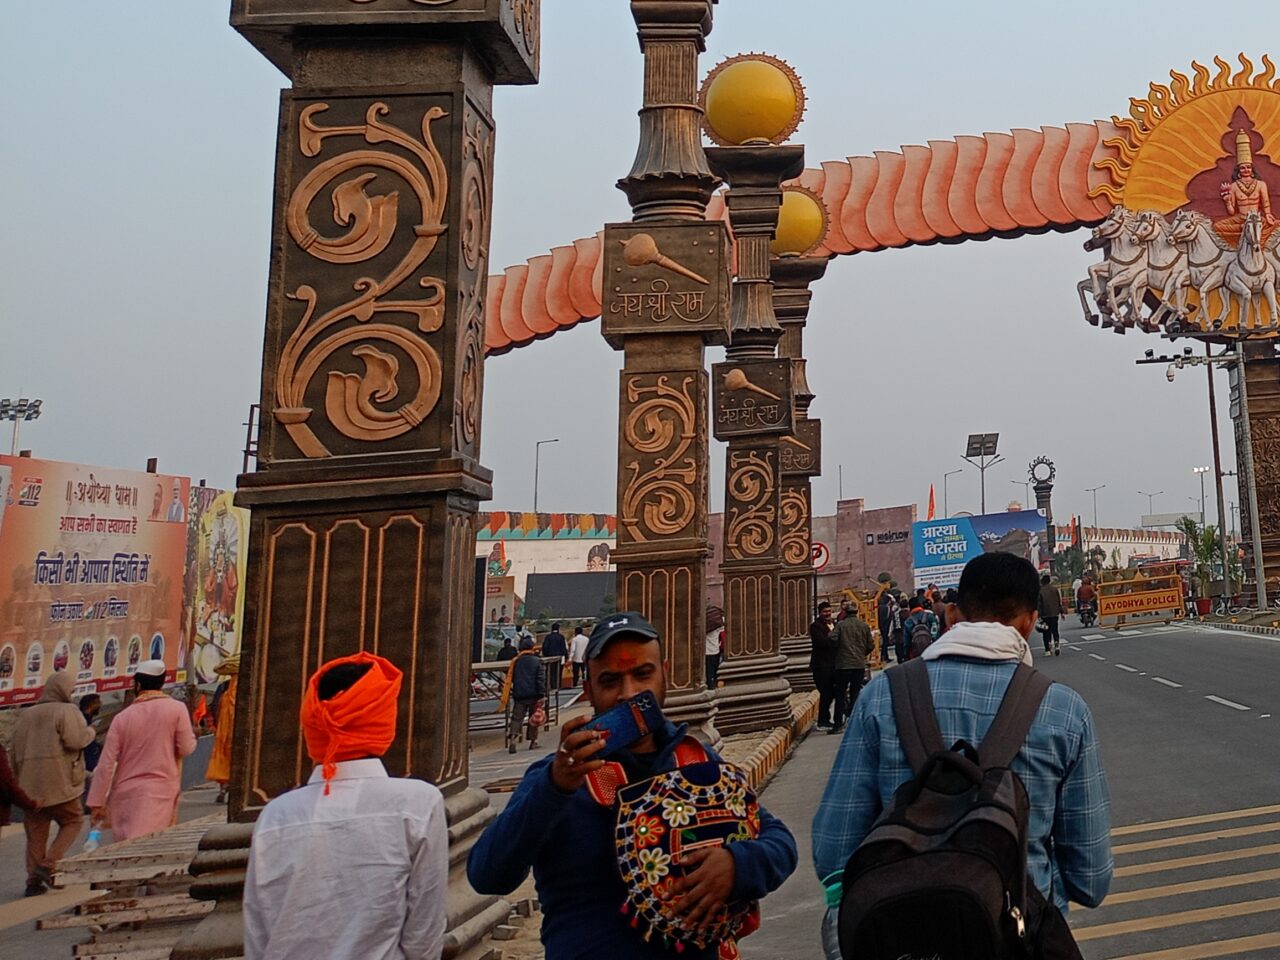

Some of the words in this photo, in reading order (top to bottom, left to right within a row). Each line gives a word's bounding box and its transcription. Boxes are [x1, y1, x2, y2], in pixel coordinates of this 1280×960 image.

[610, 292, 647, 317] जय
[645, 278, 672, 322] श्री
[671, 290, 717, 322] राम
[718, 408, 740, 424] जय
[59, 516, 75, 531] आप
[77, 513, 95, 532] सभी
[97, 518, 107, 532] का
[921, 524, 957, 538] आस्था
[924, 540, 967, 555] विरासत
[34, 551, 64, 584] किसी
[64, 552, 79, 583] भी
[81, 559, 110, 583] आपात
[111, 553, 139, 583] स्थिति
[1104, 599, 1145, 611] AYODHYA
[1146, 595, 1177, 606] POLICE
